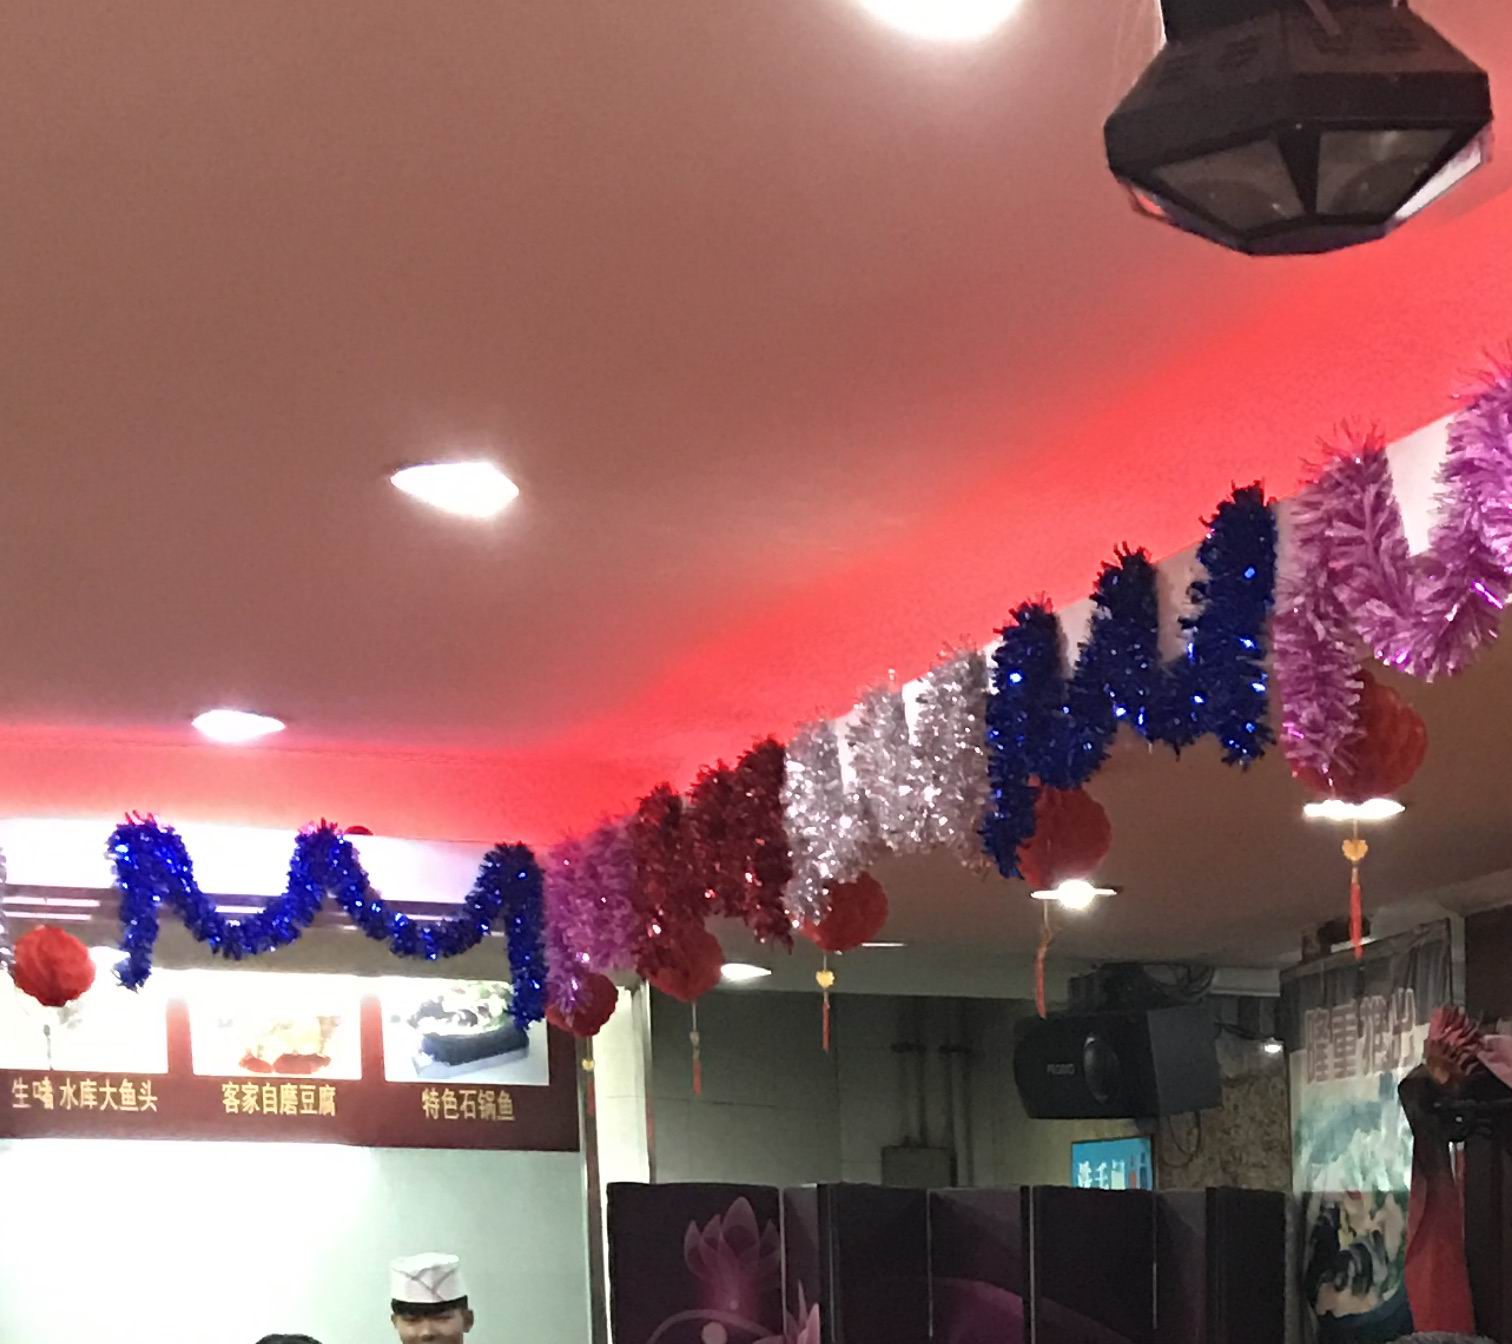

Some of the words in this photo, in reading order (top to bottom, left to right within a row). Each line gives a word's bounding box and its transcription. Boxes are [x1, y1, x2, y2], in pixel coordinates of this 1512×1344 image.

[222, 1081, 336, 1116] 客家自磨豆腐
[422, 1087, 516, 1120] 特色石锅鱼
